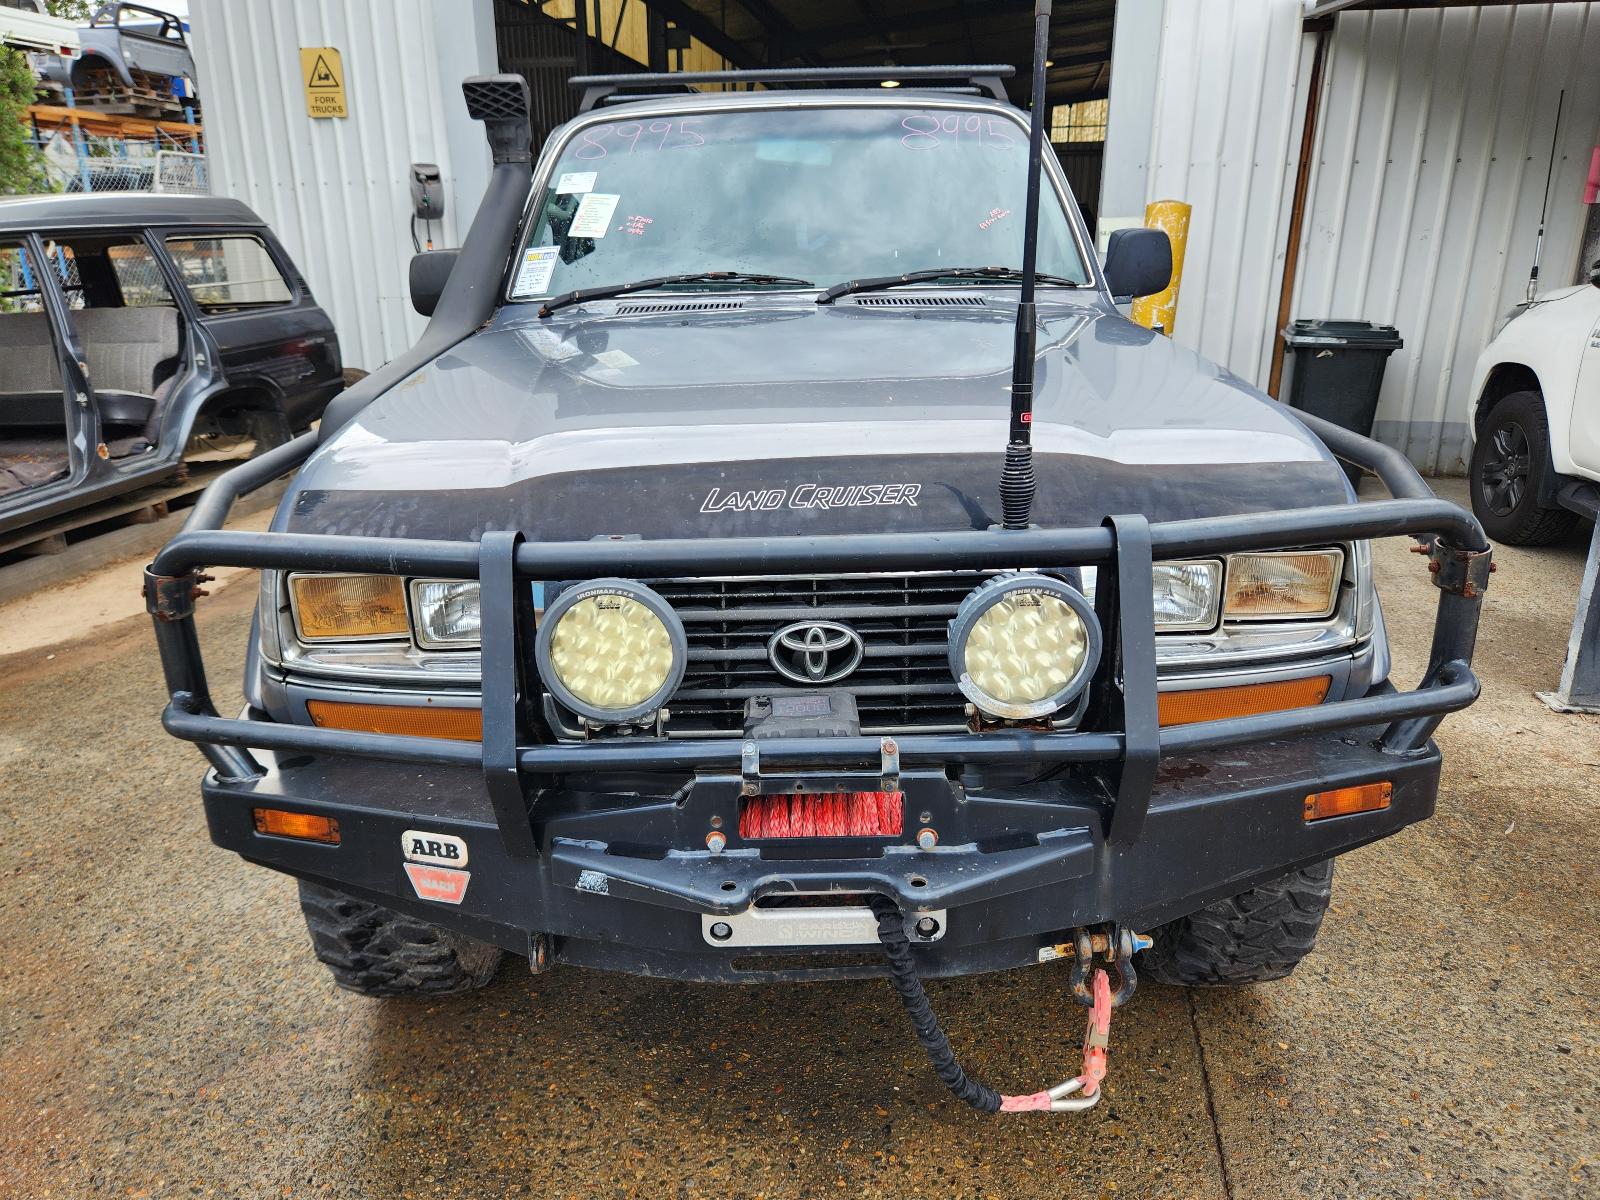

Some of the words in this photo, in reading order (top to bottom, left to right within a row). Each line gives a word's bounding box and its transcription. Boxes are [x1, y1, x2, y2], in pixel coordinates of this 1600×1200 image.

[314, 96, 337, 104] FORK
[311, 105, 344, 114] TRUCKS
[901, 114, 1016, 152] 8995
[576, 120, 705, 160] 8995
[700, 487, 786, 512] LAND
[788, 484, 921, 510] CRUISER
[576, 589, 615, 600] IRONMAN
[1003, 588, 1043, 600] IRONMAN
[411, 838, 460, 860] ARB
[799, 929, 870, 939] WINCH
